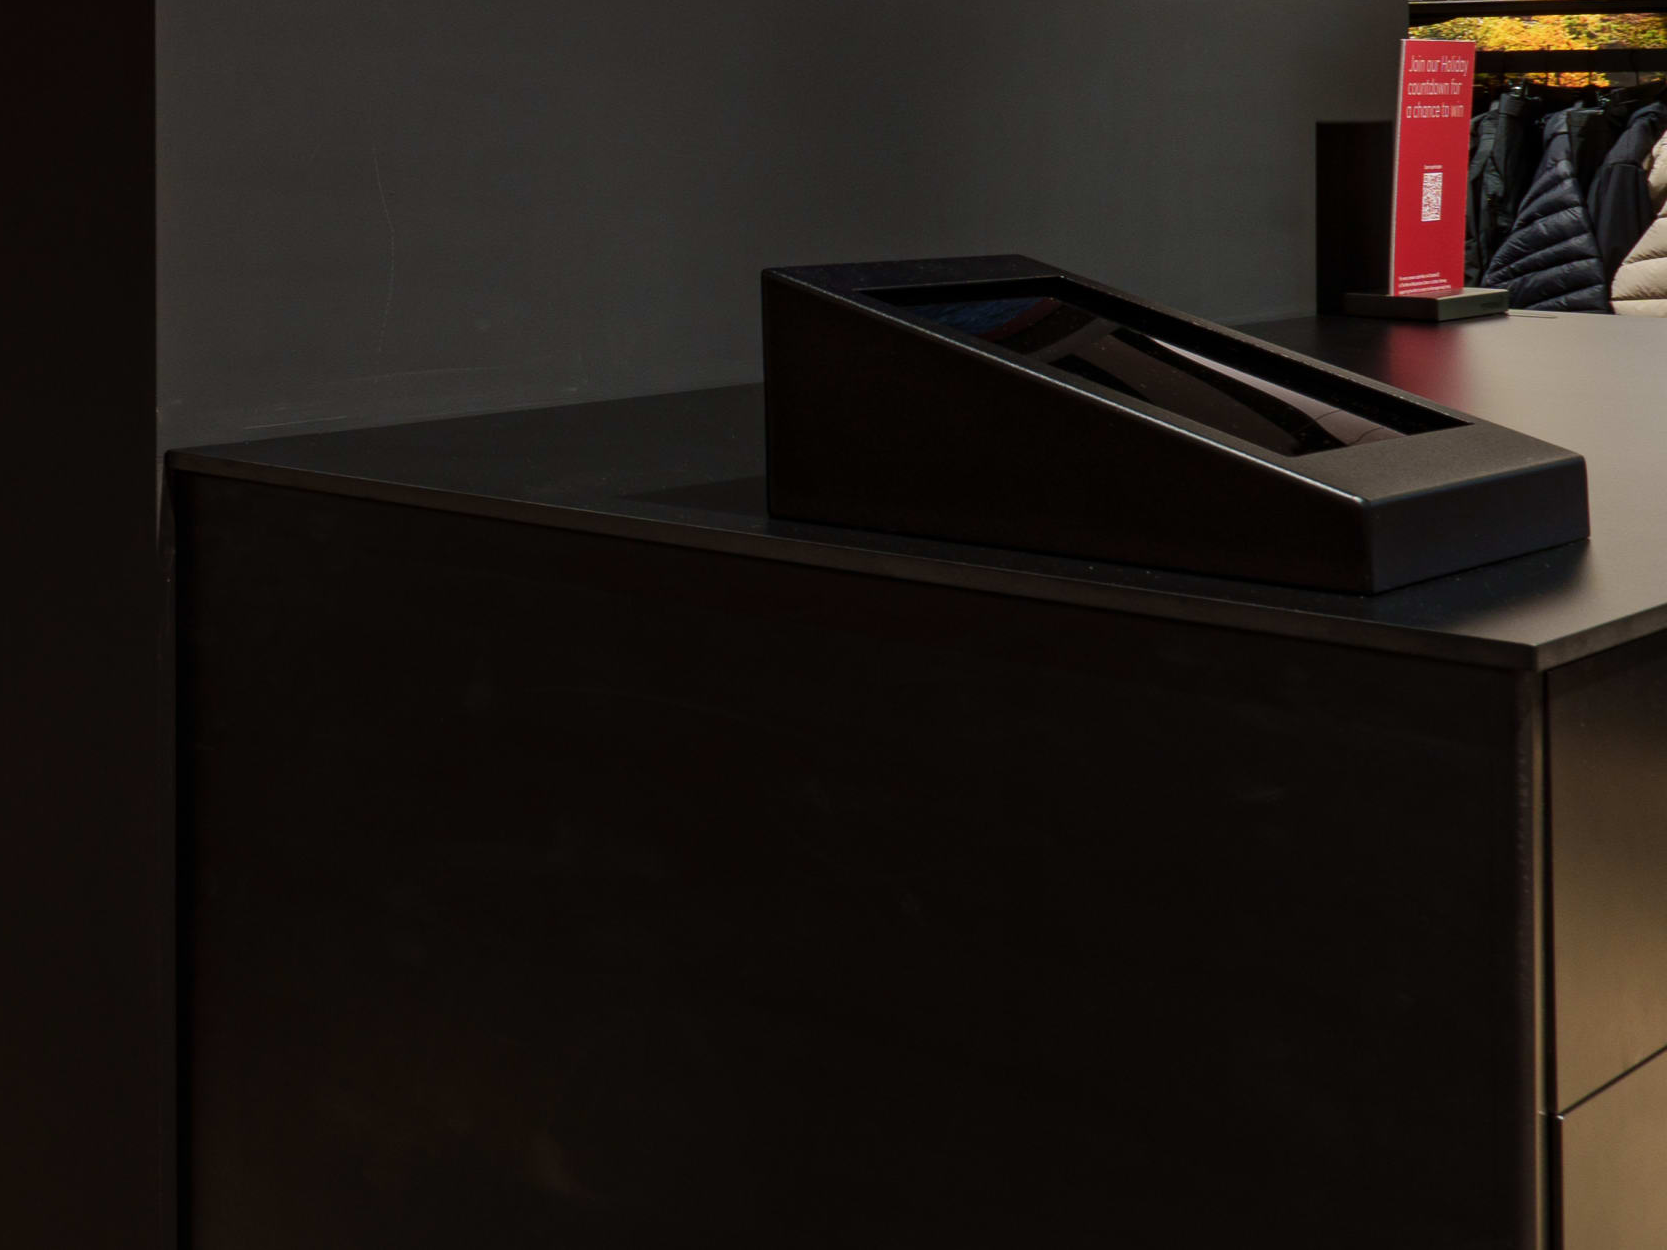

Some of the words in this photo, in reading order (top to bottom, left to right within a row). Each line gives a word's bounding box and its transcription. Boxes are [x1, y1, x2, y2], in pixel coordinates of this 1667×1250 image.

[1409, 55, 1426, 72] Join
[1427, 60, 1440, 72] our
[1441, 55, 1469, 77] Holiday
[1407, 78, 1450, 95] countdown
[1451, 78, 1463, 95] for
[1413, 101, 1441, 118] chance
[1442, 103, 1450, 118] to
[1451, 101, 1464, 118] win
